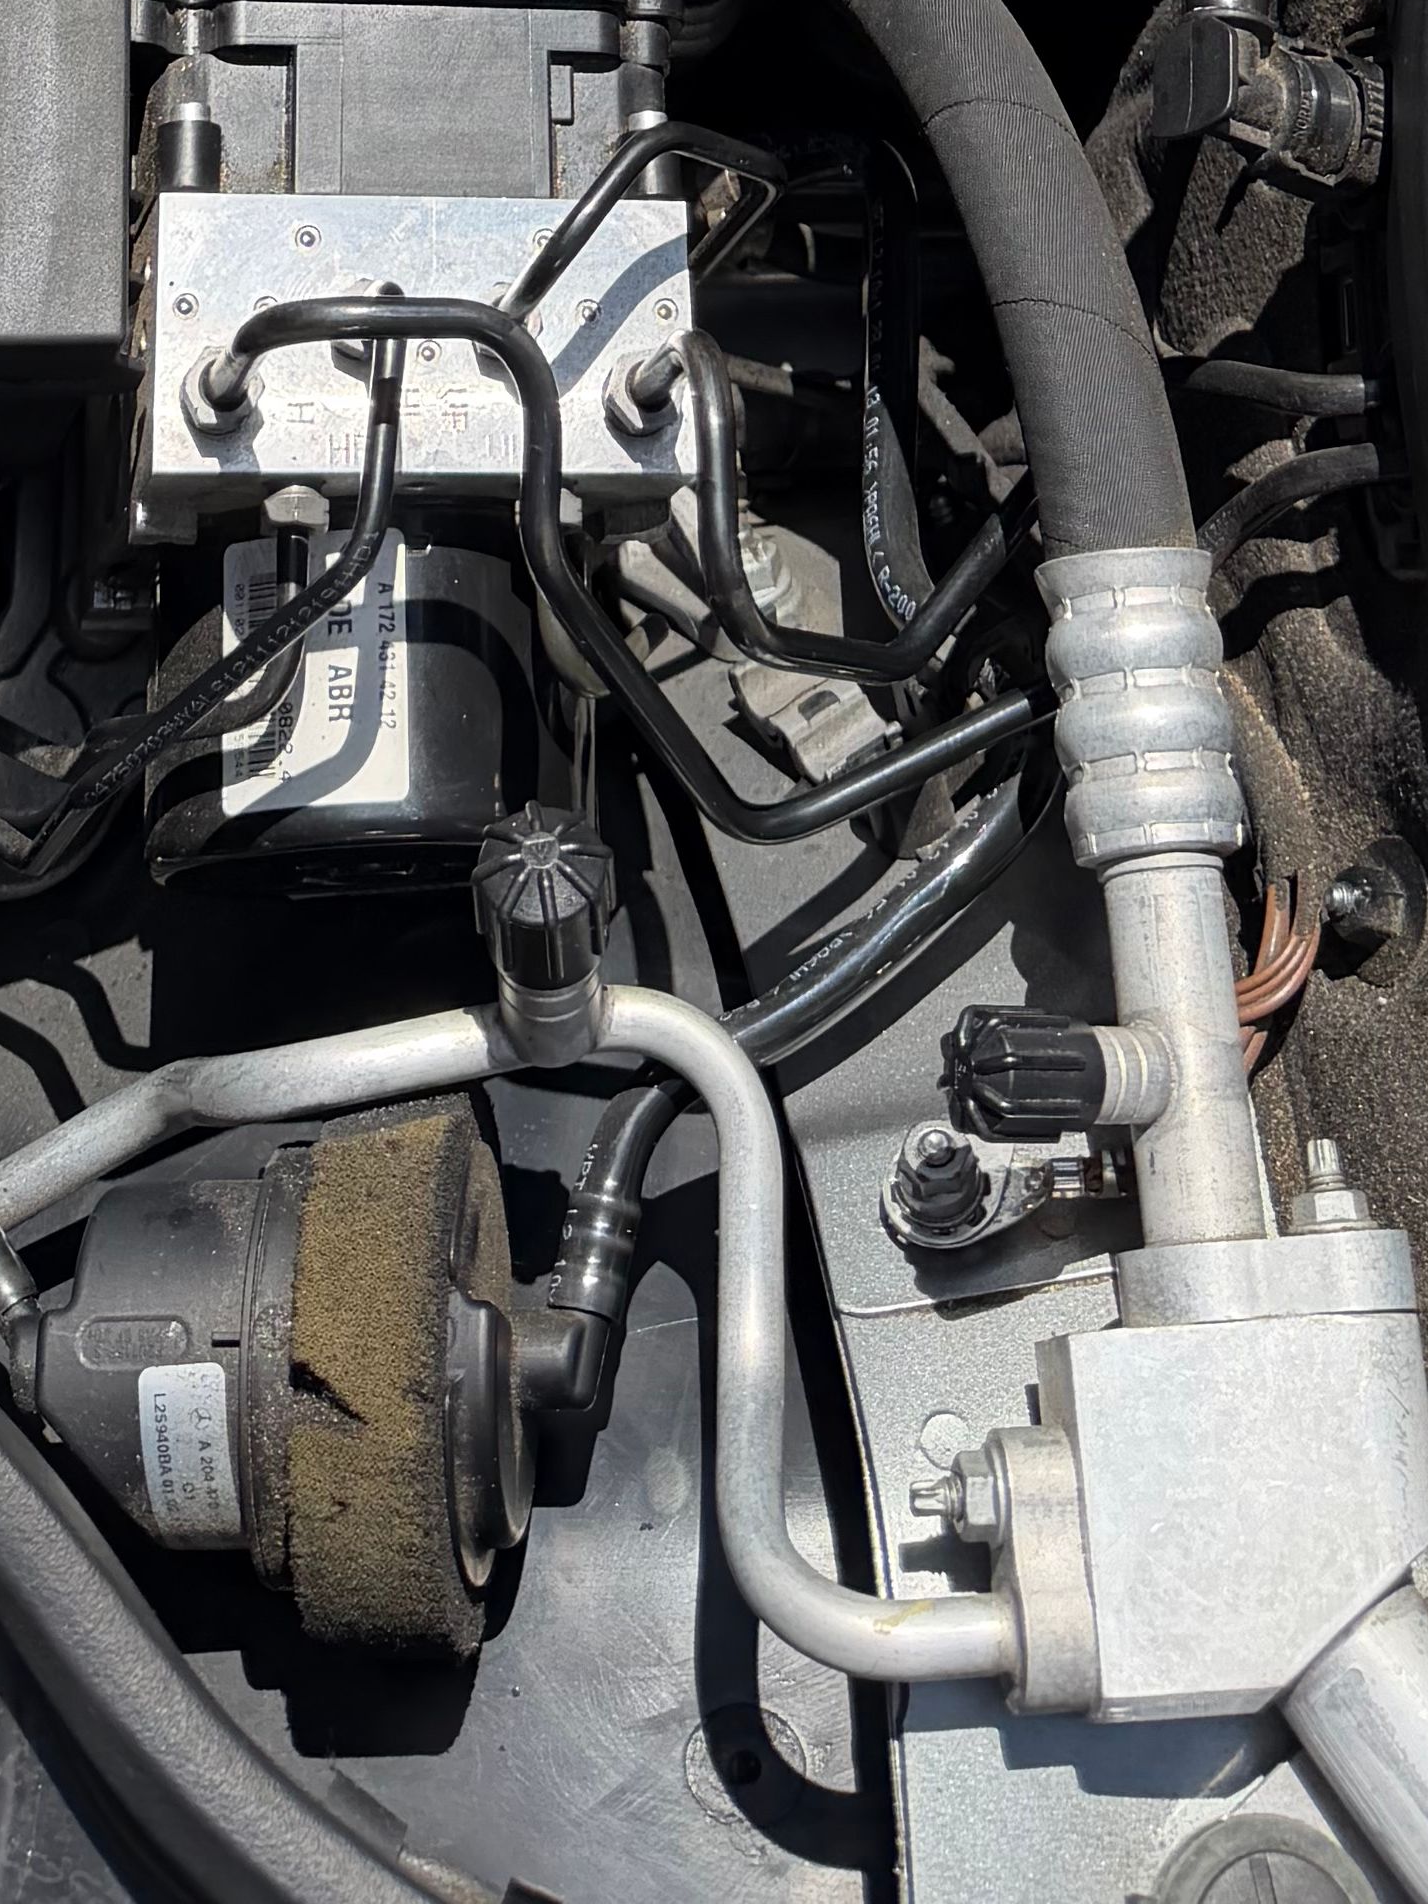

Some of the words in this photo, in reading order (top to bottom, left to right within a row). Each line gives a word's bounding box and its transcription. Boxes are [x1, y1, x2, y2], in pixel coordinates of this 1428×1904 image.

[378, 582, 394, 595] A
[378, 603, 396, 632] 172
[328, 664, 354, 722] ABR
[380, 709, 398, 730] 12
[198, 1440, 212, 1452] A
[200, 1456, 215, 1483] 204
